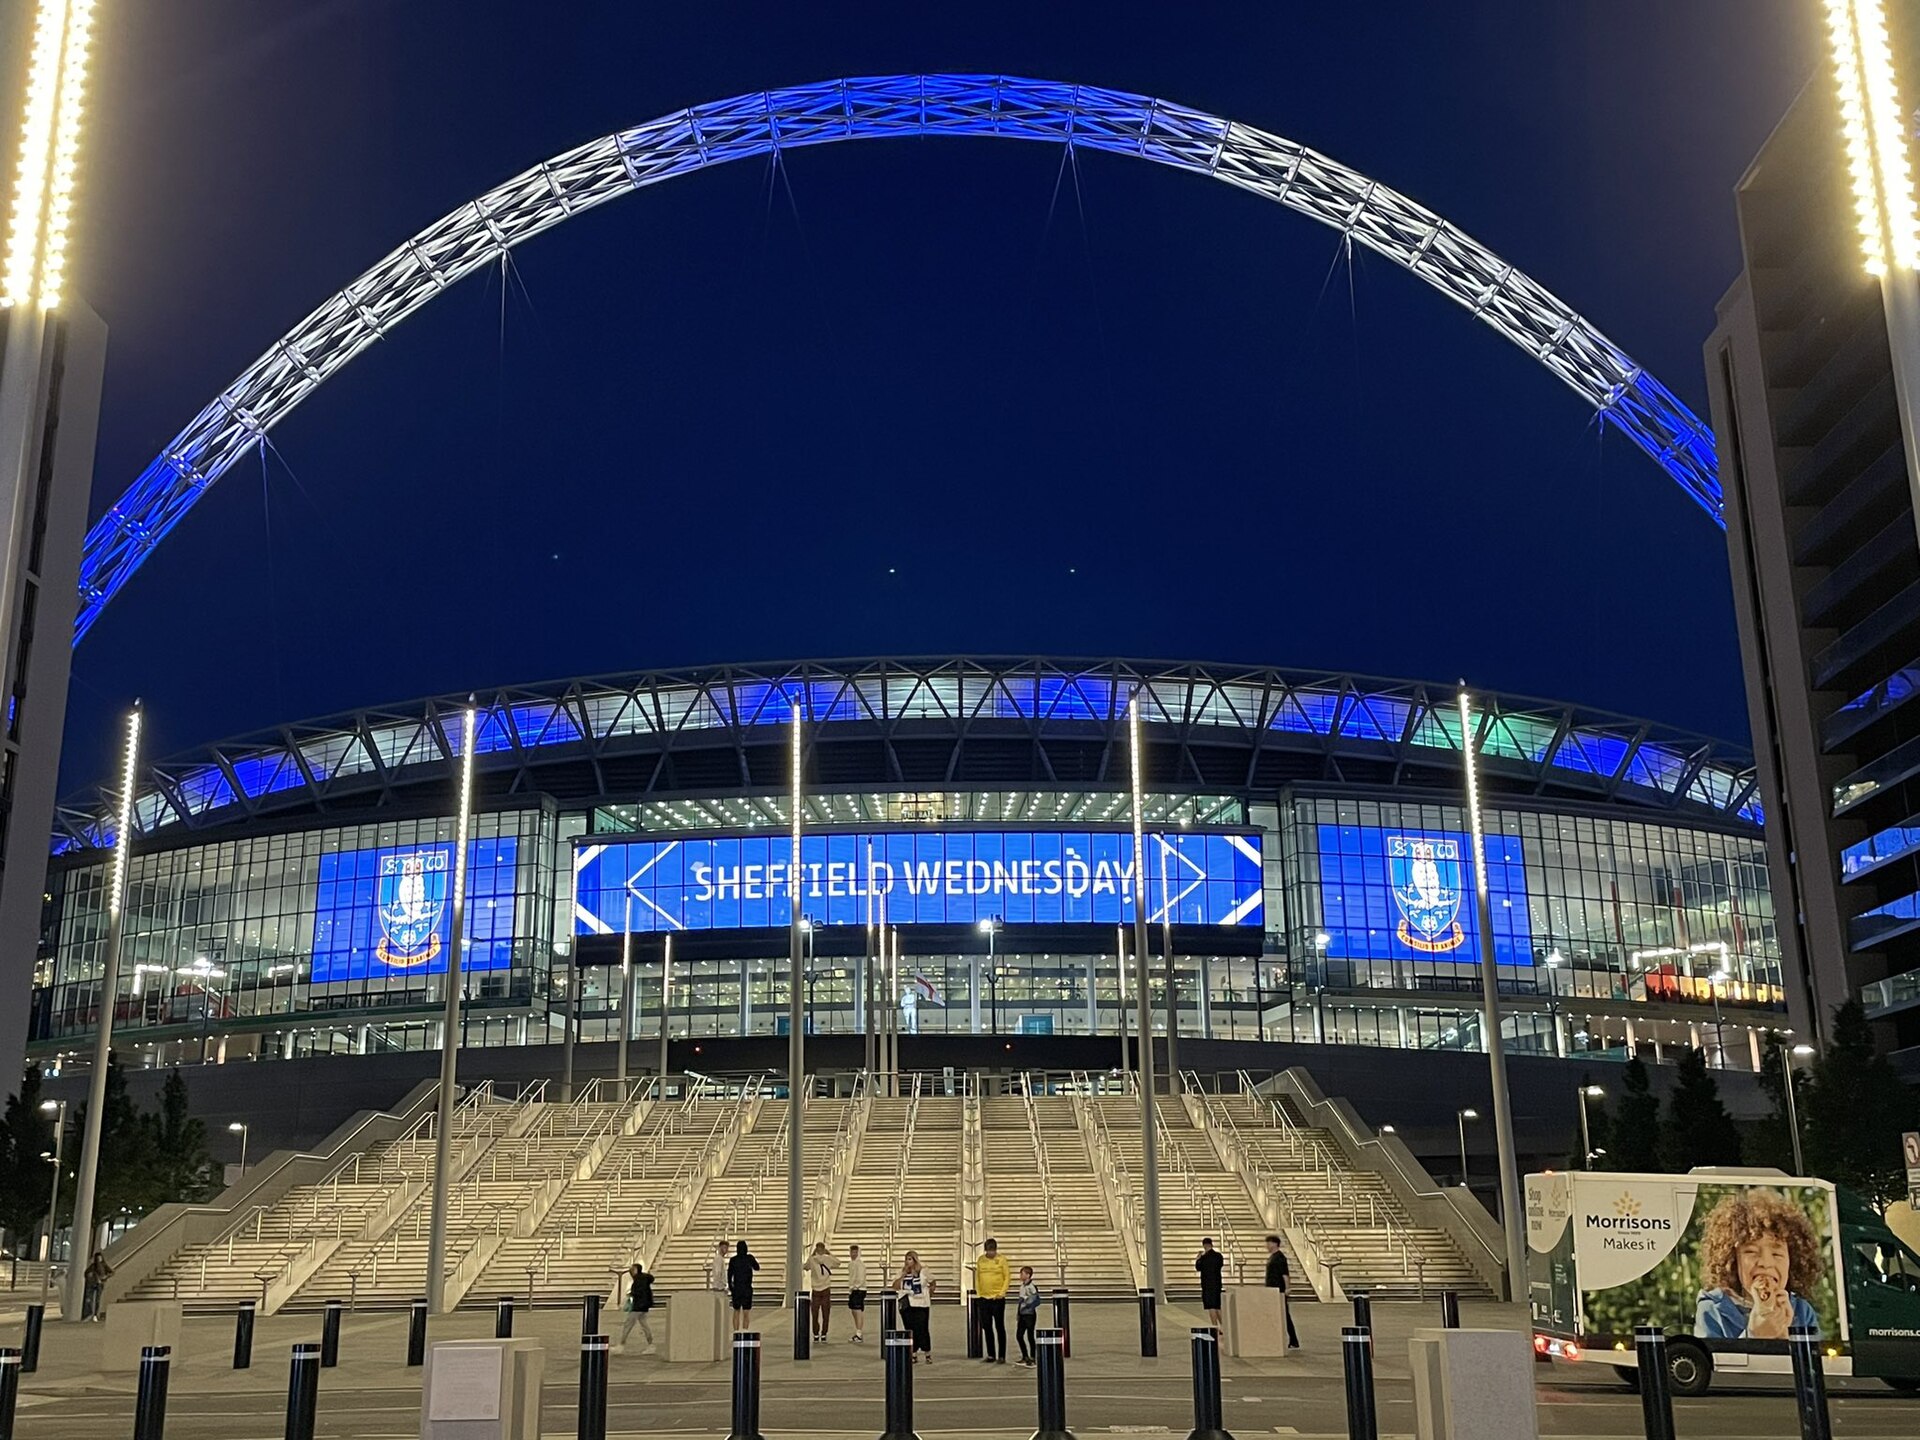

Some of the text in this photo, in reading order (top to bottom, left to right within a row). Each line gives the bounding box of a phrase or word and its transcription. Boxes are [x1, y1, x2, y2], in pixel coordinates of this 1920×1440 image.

[695, 859, 1135, 901] SHEFFIELD WEDNESDAY
[1586, 1213, 1672, 1230] Morrisons
[1603, 1238, 1657, 1251] Makes it
